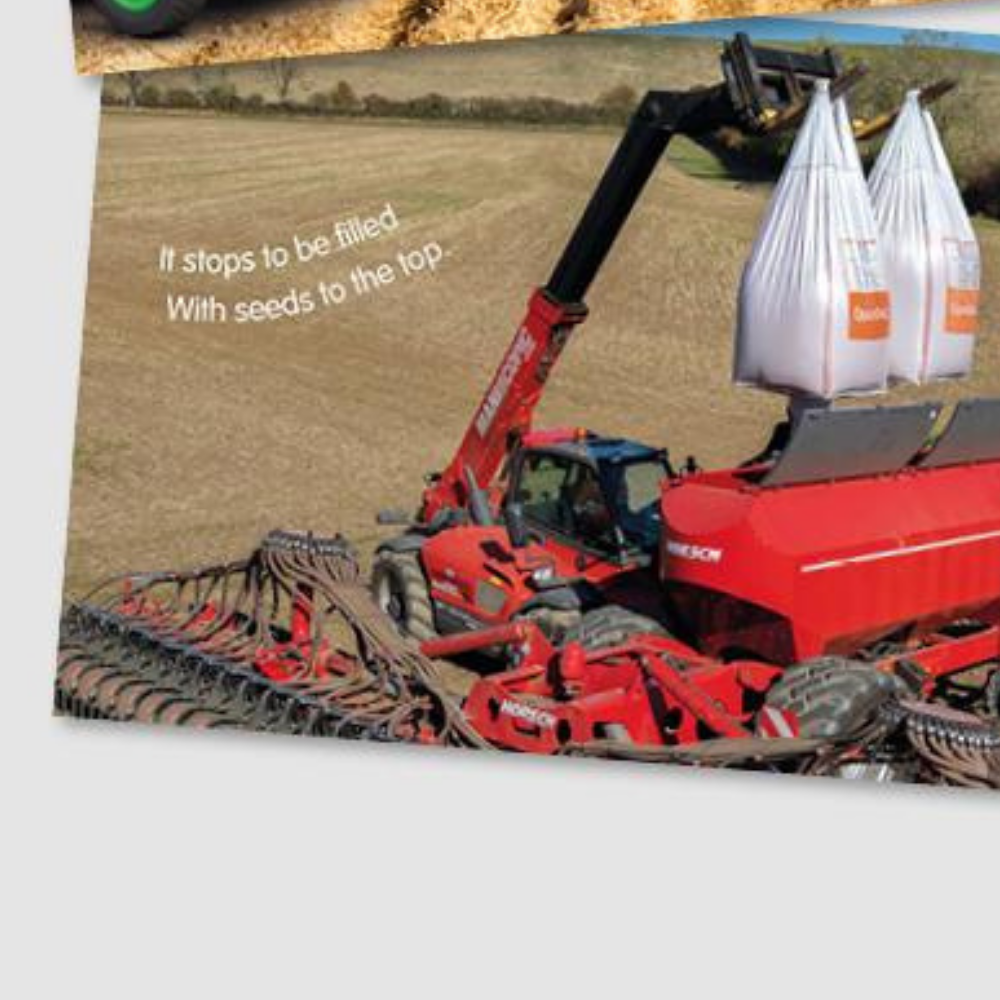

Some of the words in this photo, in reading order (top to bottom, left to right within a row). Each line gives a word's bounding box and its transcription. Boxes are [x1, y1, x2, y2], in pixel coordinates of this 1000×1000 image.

[158, 244, 174, 273] It
[182, 248, 256, 280] stops
[261, 243, 289, 268] to
[292, 234, 330, 263] be
[334, 203, 400, 250] filled
[166, 293, 227, 323] With
[234, 289, 316, 324] seeds
[317, 280, 347, 306] to
[349, 266, 396, 297] the
[396, 240, 453, 277] top.
